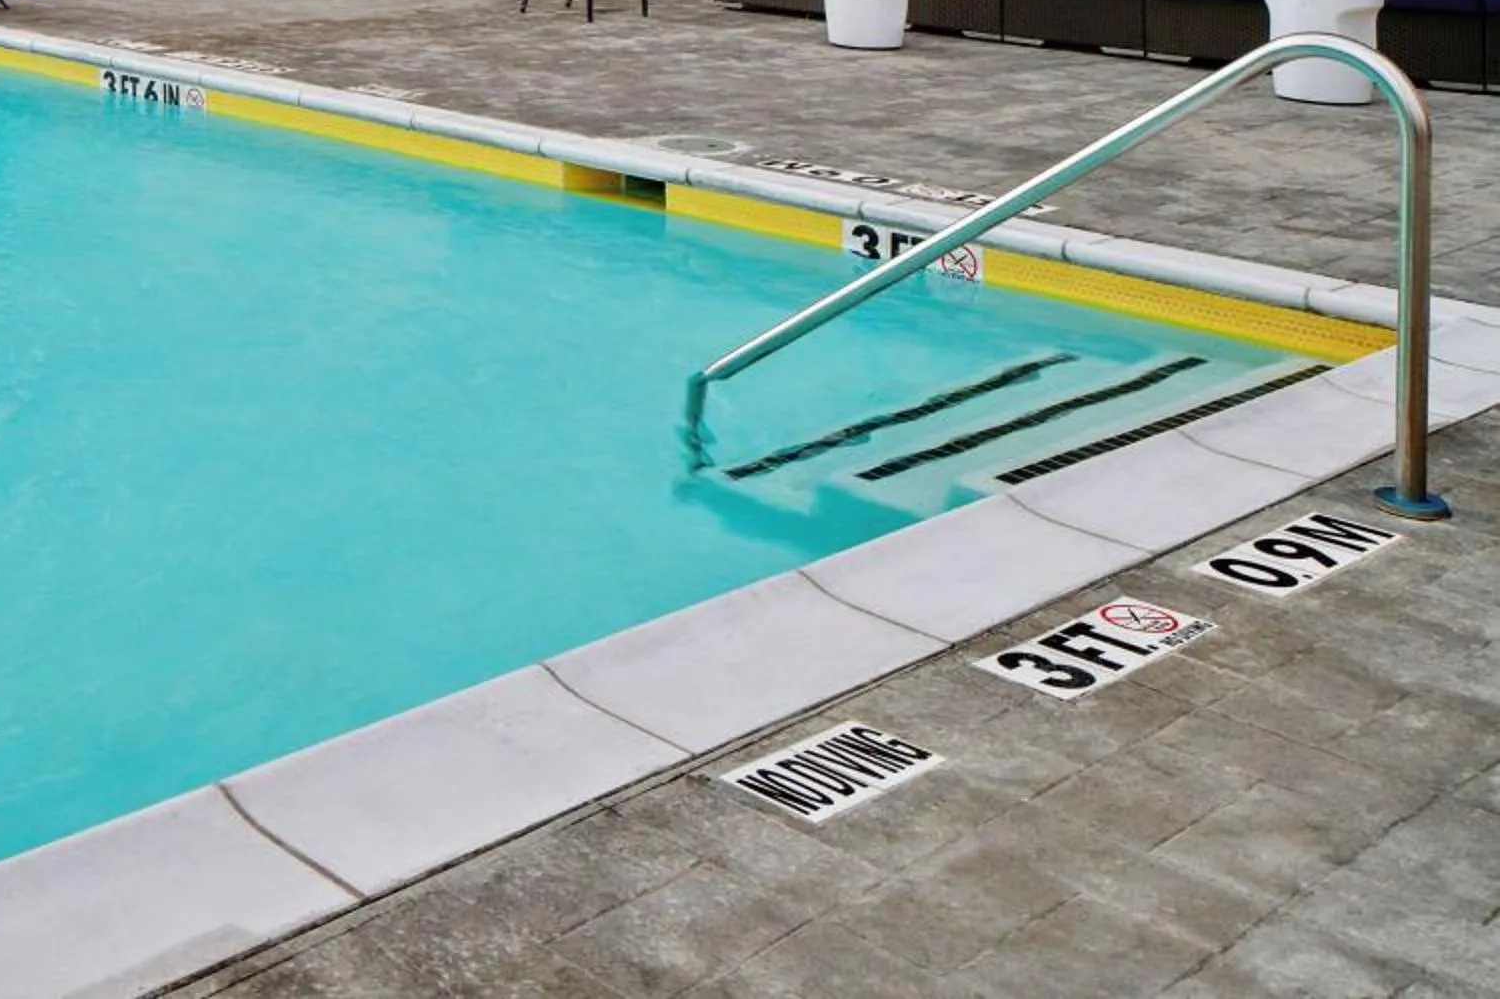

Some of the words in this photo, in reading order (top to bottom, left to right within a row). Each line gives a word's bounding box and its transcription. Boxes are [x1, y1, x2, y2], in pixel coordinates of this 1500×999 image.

[103, 71, 116, 93] 3
[121, 75, 140, 97] FT
[144, 80, 159, 102] 6
[163, 83, 180, 106] IN
[851, 224, 881, 260] 3
[1209, 514, 1396, 588] 0.9M
[1038, 621, 1159, 672] FT.
[997, 652, 1097, 689] 3
[775, 727, 933, 797] DIVING
[736, 768, 835, 815] NO
